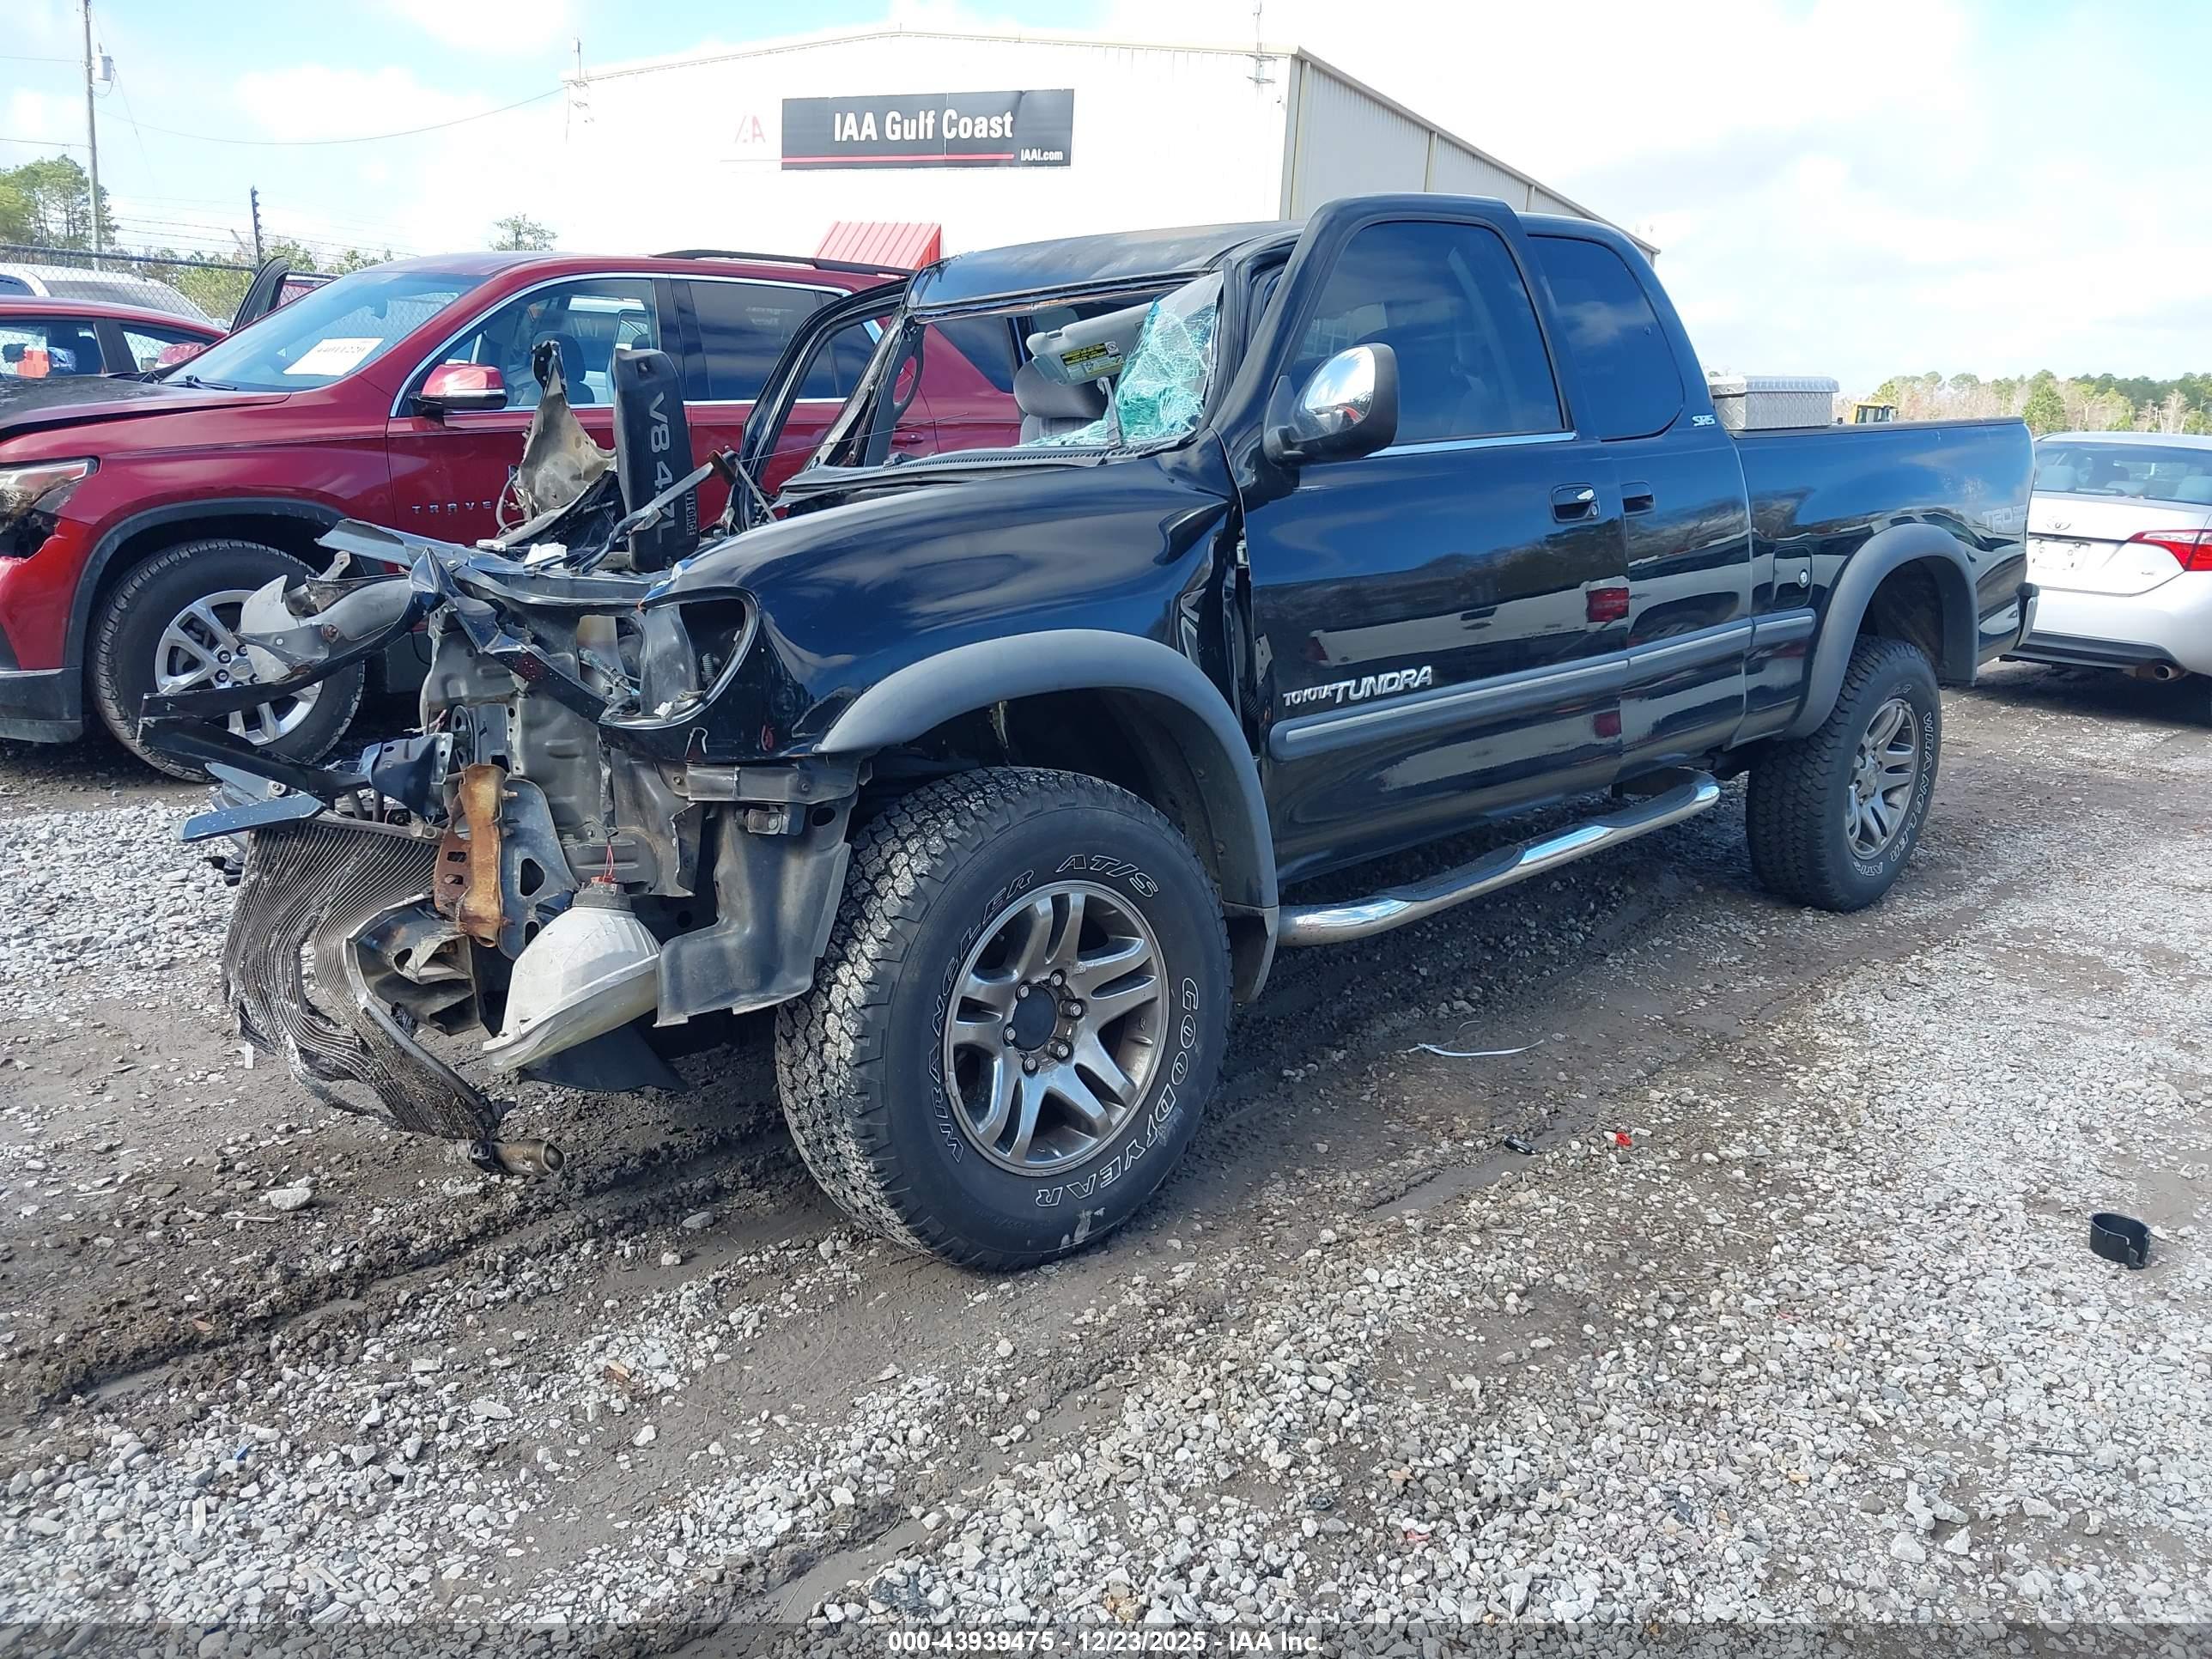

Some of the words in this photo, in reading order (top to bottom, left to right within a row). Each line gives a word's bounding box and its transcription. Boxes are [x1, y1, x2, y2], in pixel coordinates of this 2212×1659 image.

[834, 112, 878, 142] IAA
[885, 110, 935, 140] Gulf
[943, 109, 1012, 139] Coast
[649, 391, 670, 453] V8
[412, 501, 507, 515] TRAVE
[1283, 685, 1333, 707] TOYOTA
[1332, 665, 1432, 704] TUNDRA
[929, 870, 1035, 1163] WRANGLER
[1035, 977, 1200, 1207] GOODYEAR
